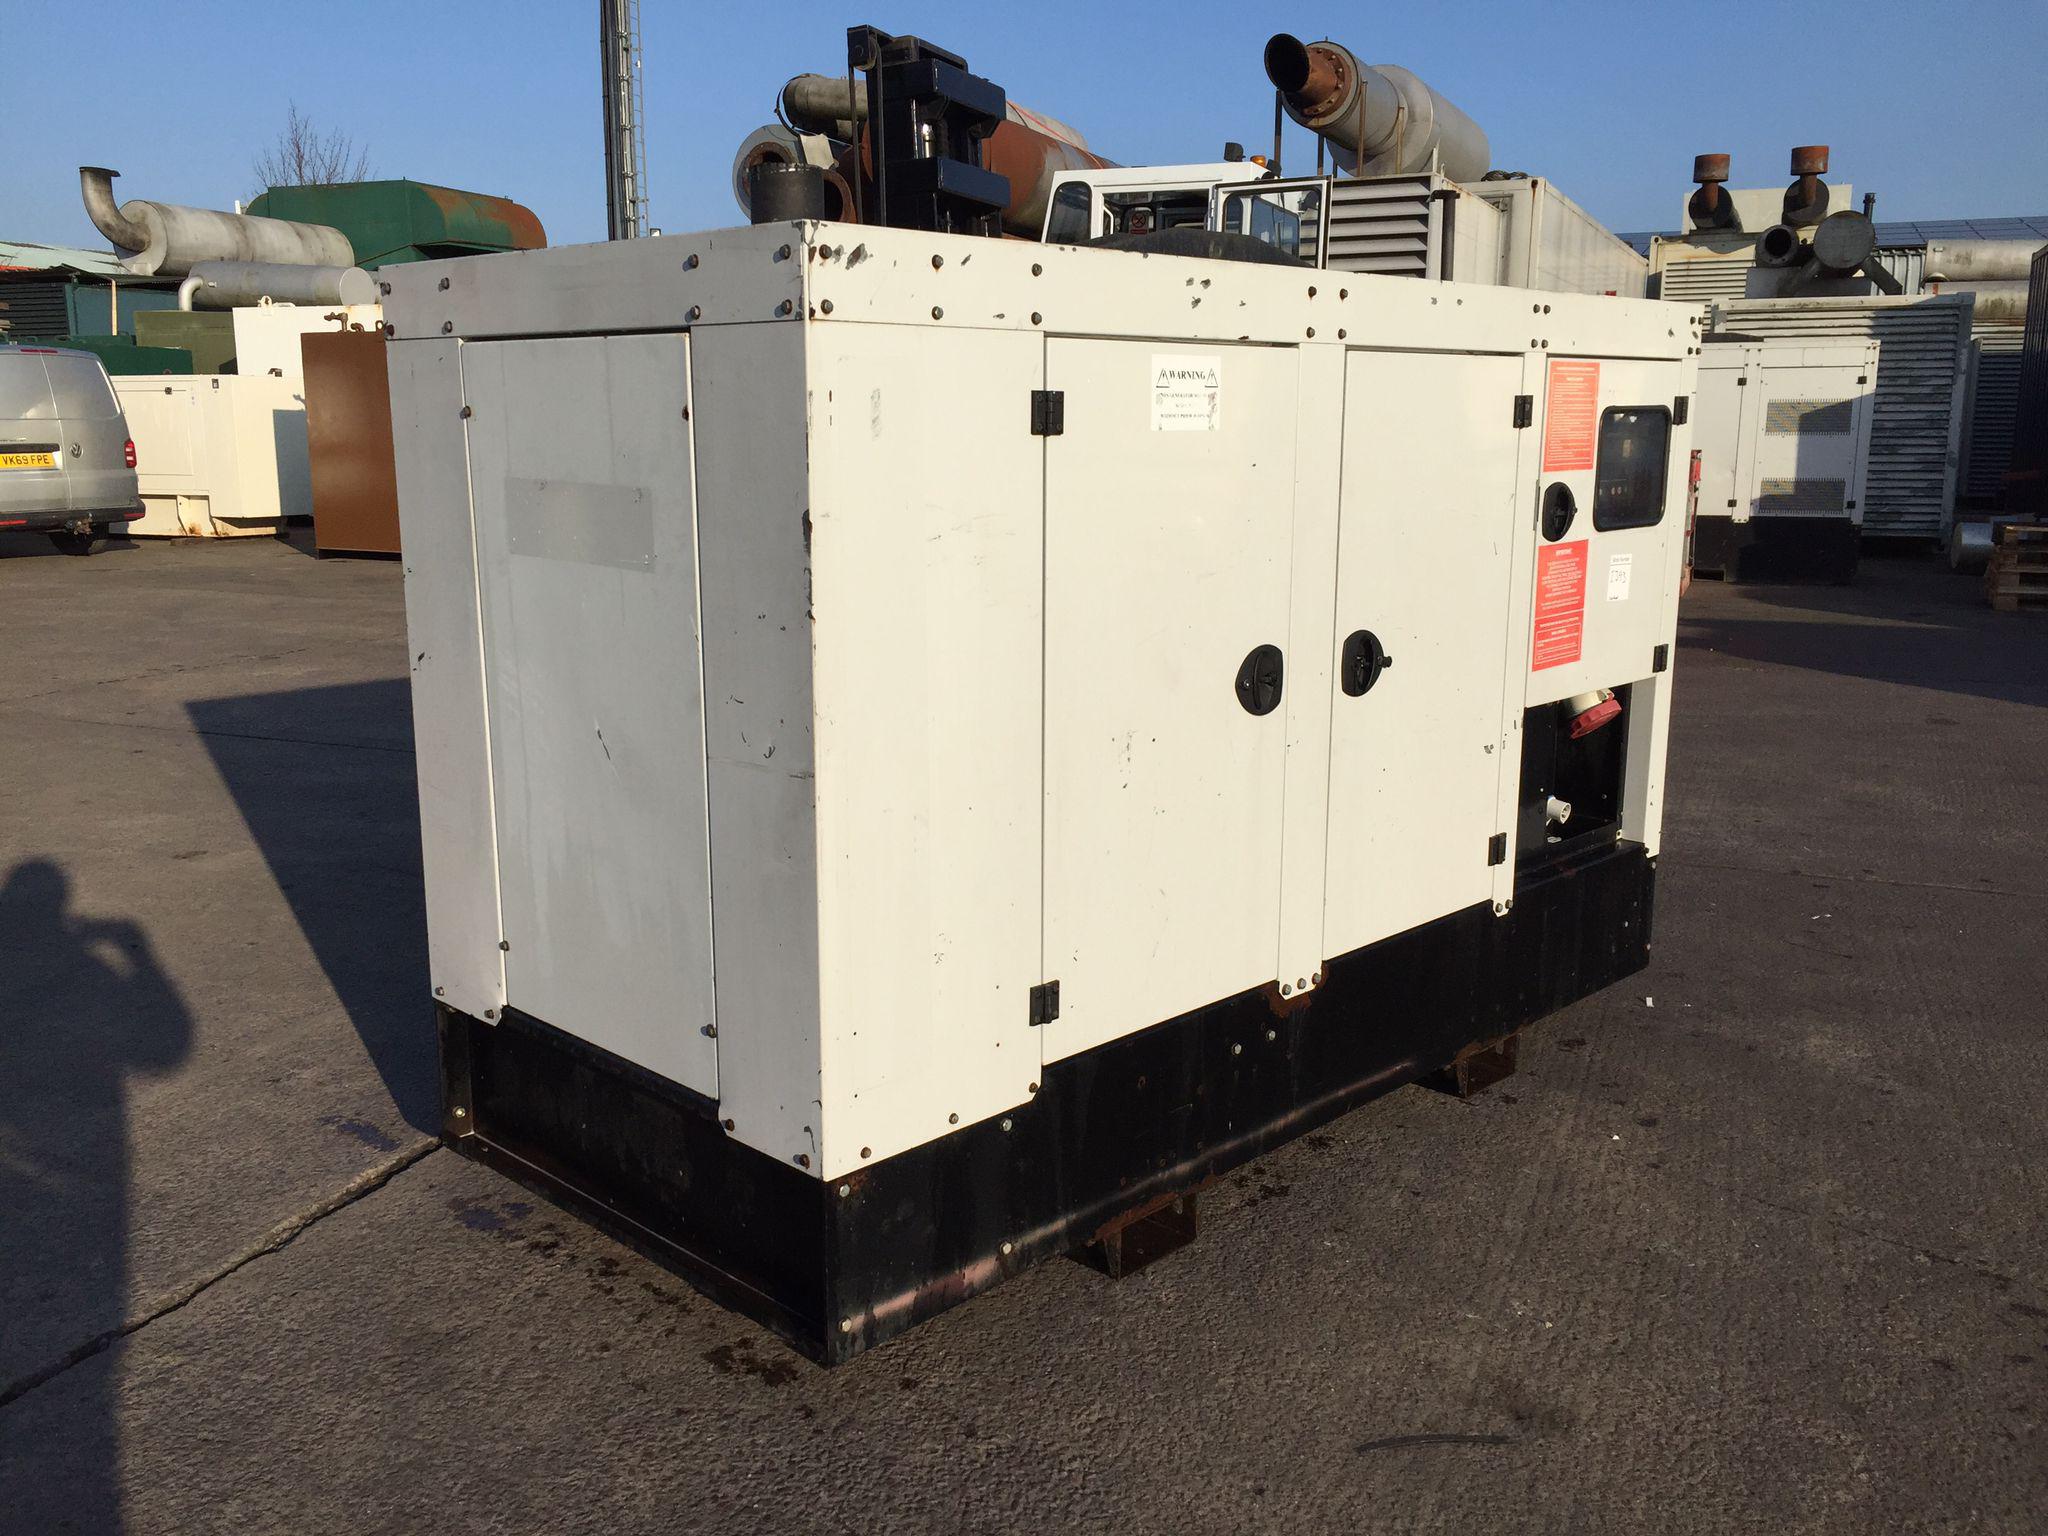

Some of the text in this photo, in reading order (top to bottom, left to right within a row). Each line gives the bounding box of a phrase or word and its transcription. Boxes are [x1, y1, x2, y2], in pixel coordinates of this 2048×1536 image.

[1169, 370, 1206, 380] WARNING
[2, 454, 50, 465] VK69 FPE
